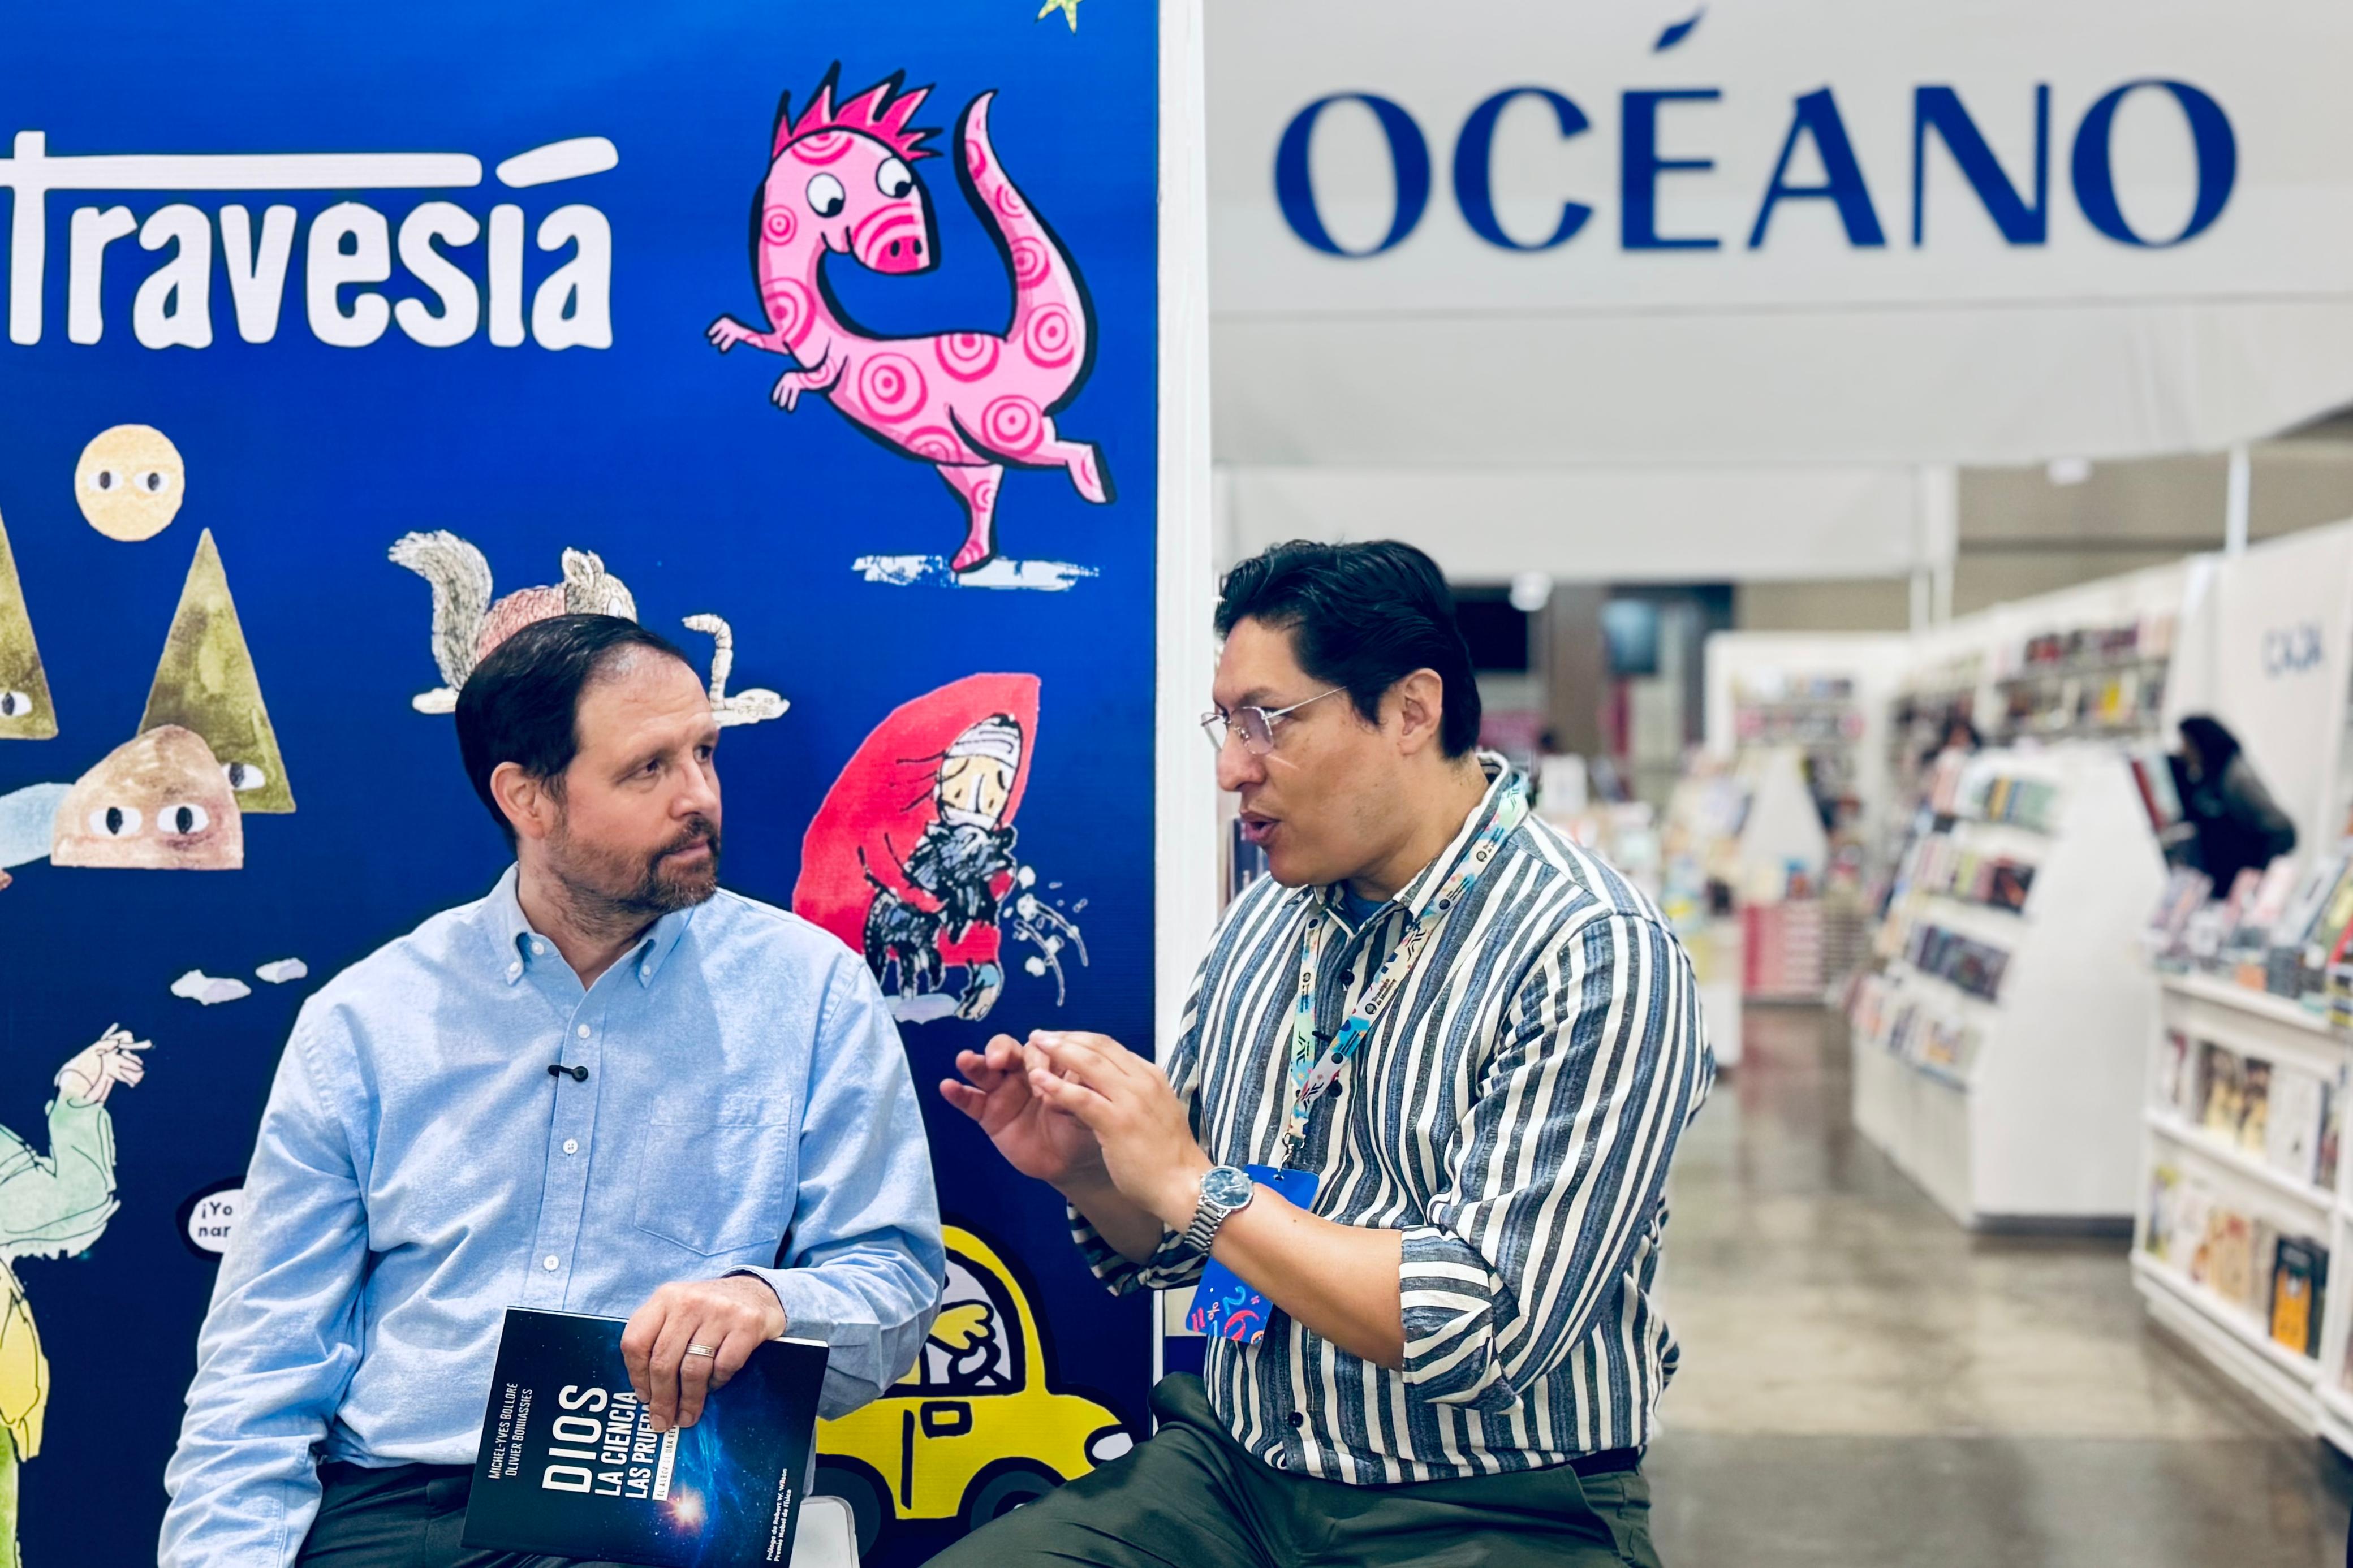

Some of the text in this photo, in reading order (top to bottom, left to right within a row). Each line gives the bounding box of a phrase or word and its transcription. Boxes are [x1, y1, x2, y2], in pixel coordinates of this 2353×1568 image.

[1274, 11, 2237, 257] OCÉANO
[201, 1200, 233, 1219] ¡Yo
[505, 1443, 522, 1476] OLIVIER
[542, 1385, 607, 1493] DIOS
[595, 1392, 640, 1496] LA CIENCIA
[625, 1467, 651, 1498] LAS
